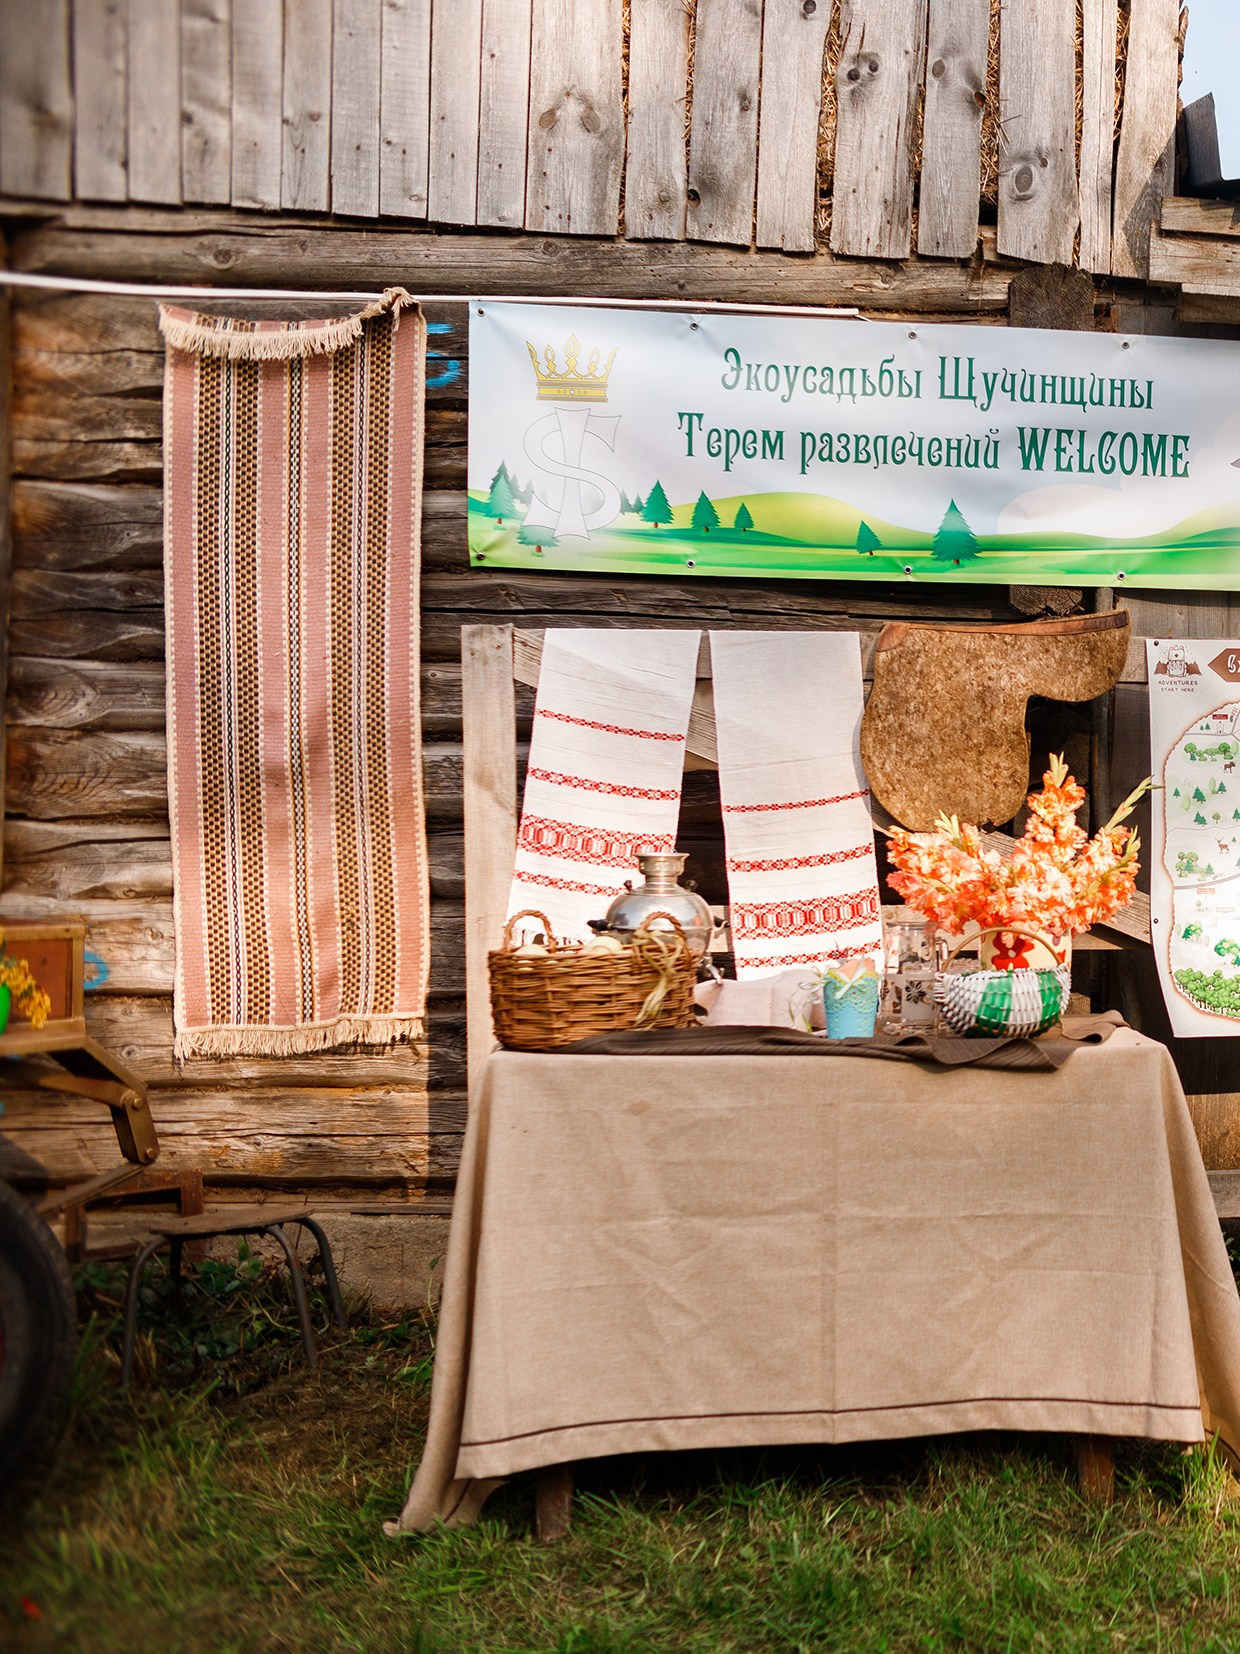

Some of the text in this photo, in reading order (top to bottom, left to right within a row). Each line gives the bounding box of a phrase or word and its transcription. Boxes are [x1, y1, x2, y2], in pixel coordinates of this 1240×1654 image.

[720, 347, 1154, 412] Экоусадьбы Щучинщины
[677, 411, 1190, 479] Терем развлечений WELCOME
